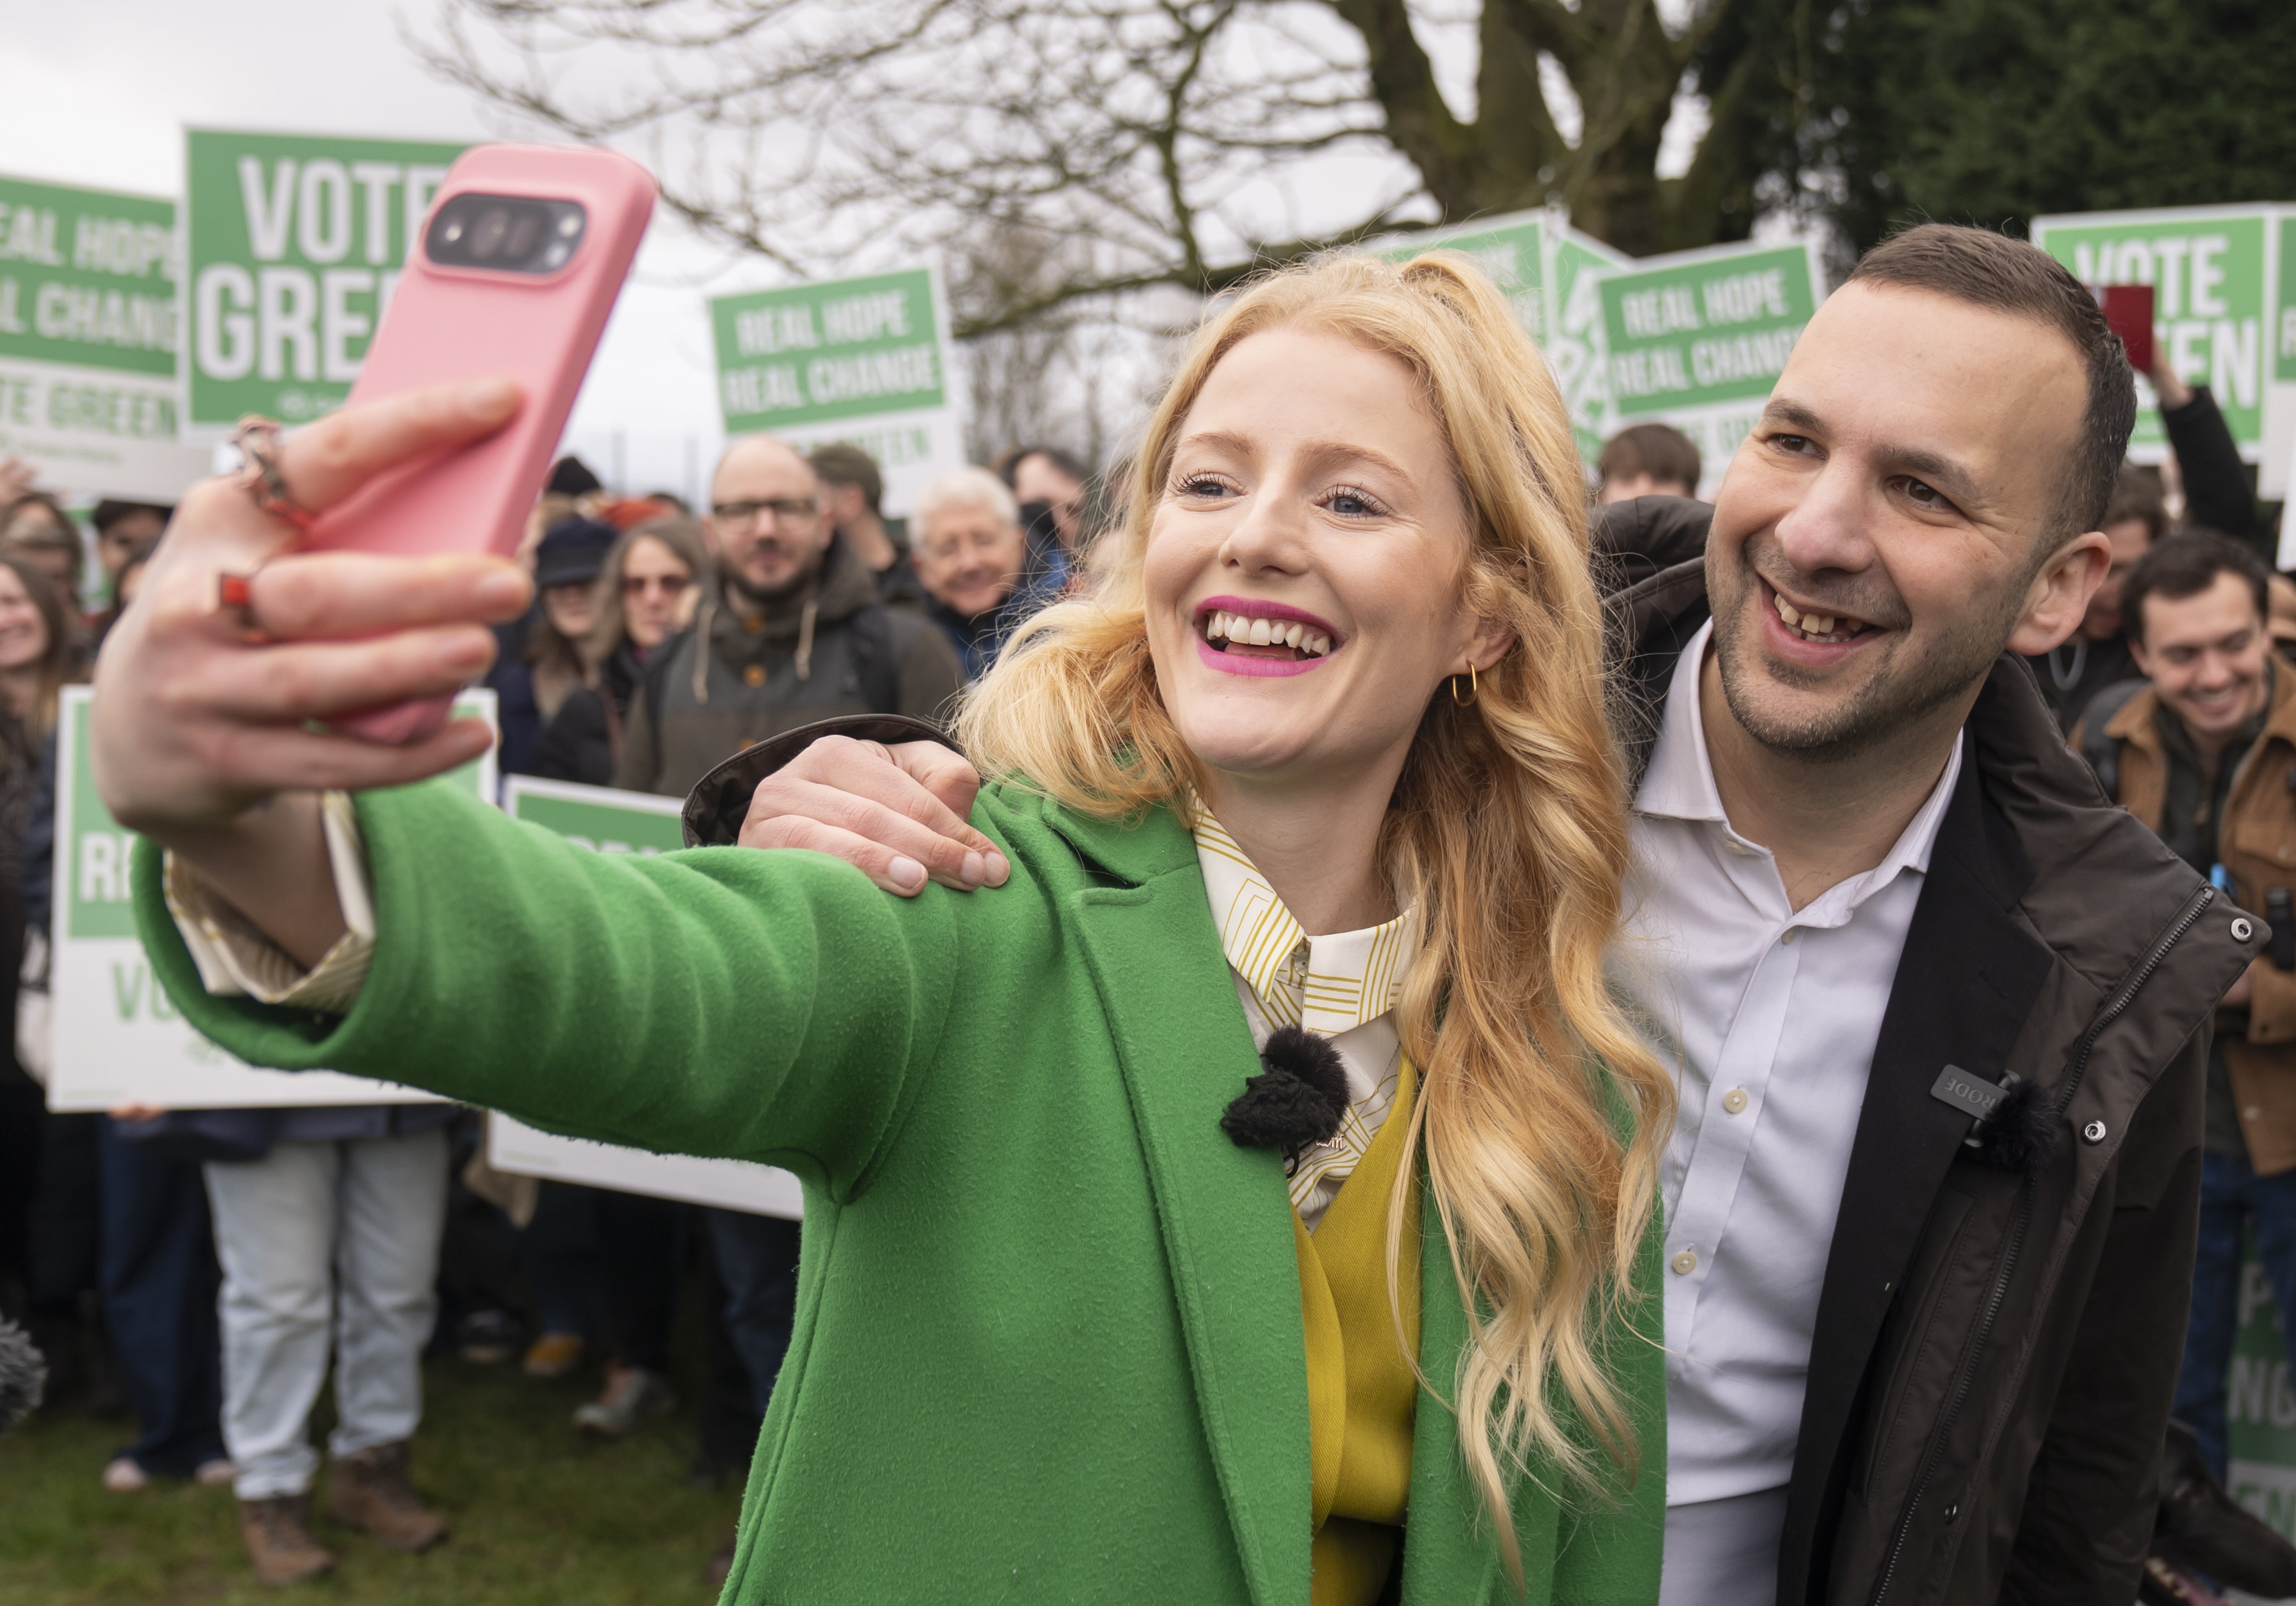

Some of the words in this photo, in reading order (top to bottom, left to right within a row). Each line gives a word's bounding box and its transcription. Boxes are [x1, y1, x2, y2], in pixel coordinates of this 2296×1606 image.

[0, 202, 63, 265] EAL
[1623, 287, 1703, 337] REAL
[1704, 270, 1788, 324] HOPE
[2076, 235, 2226, 317] VOTE
[37, 282, 177, 352] CHANG
[197, 265, 402, 380] GRE
[737, 305, 819, 355] REAL
[824, 290, 910, 344] HOPE
[1614, 346, 1691, 397] REAL
[1692, 325, 1805, 385] CHANG
